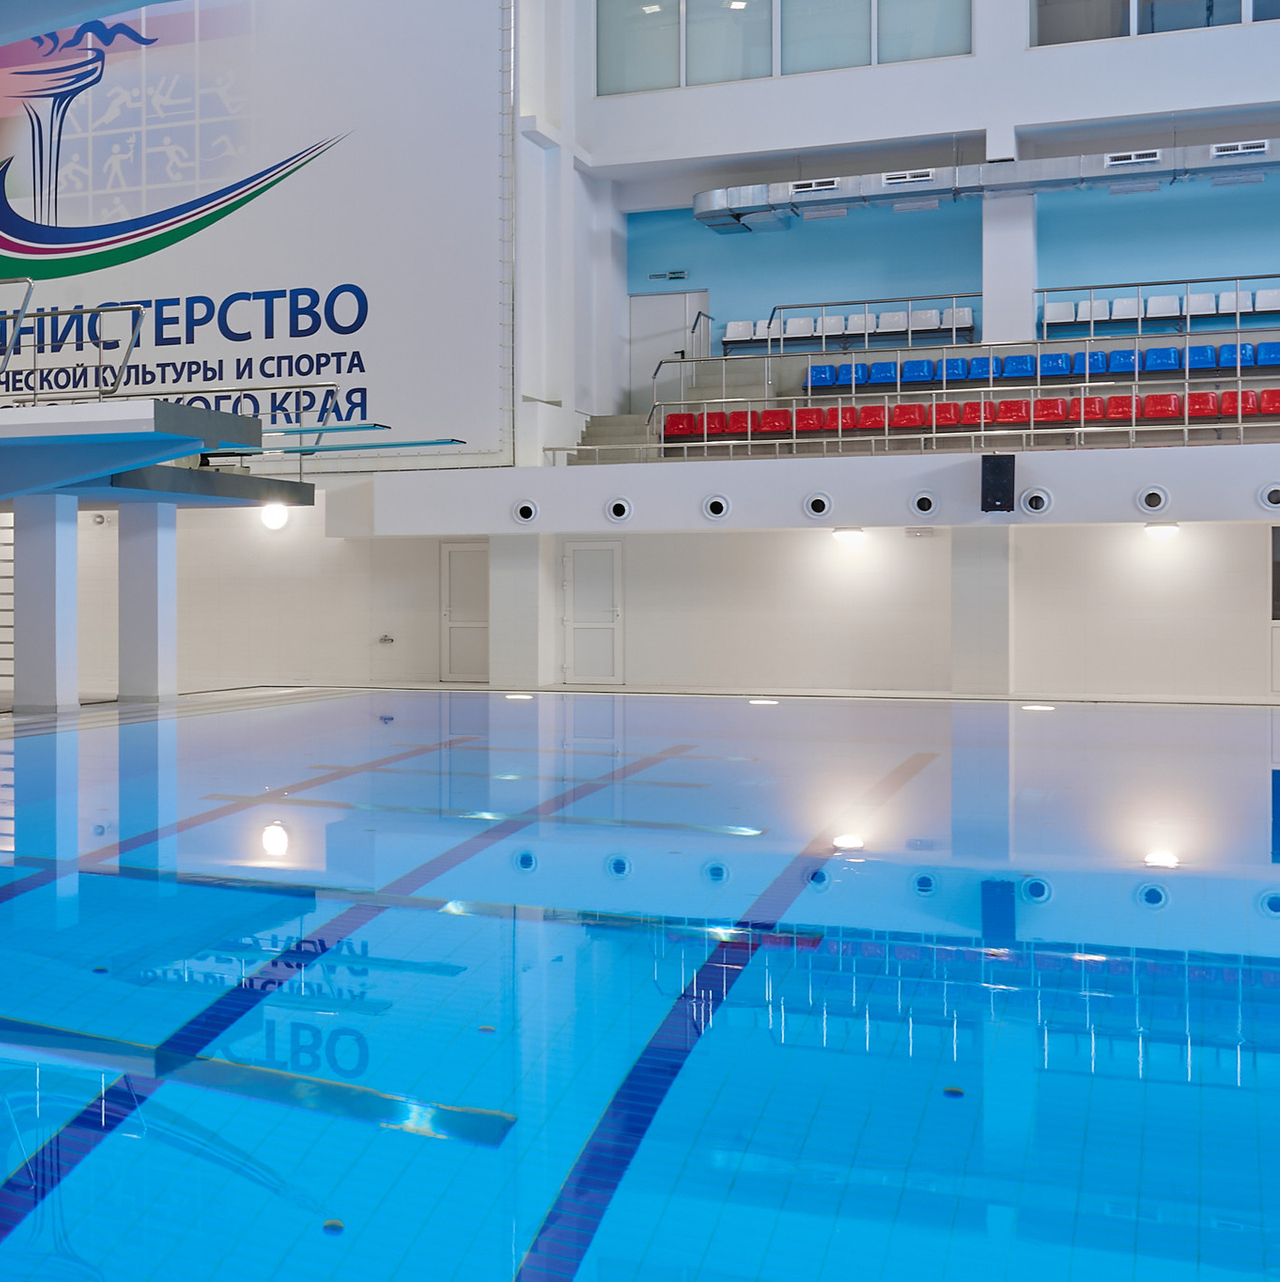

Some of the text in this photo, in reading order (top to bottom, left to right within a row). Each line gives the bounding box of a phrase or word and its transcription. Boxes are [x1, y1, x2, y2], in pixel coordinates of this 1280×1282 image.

[94, 358, 224, 390] КУЛЬТУРЫ
[235, 357, 253, 380] И
[259, 350, 366, 379] СПОРТА
[270, 387, 368, 425] КРАЯ
